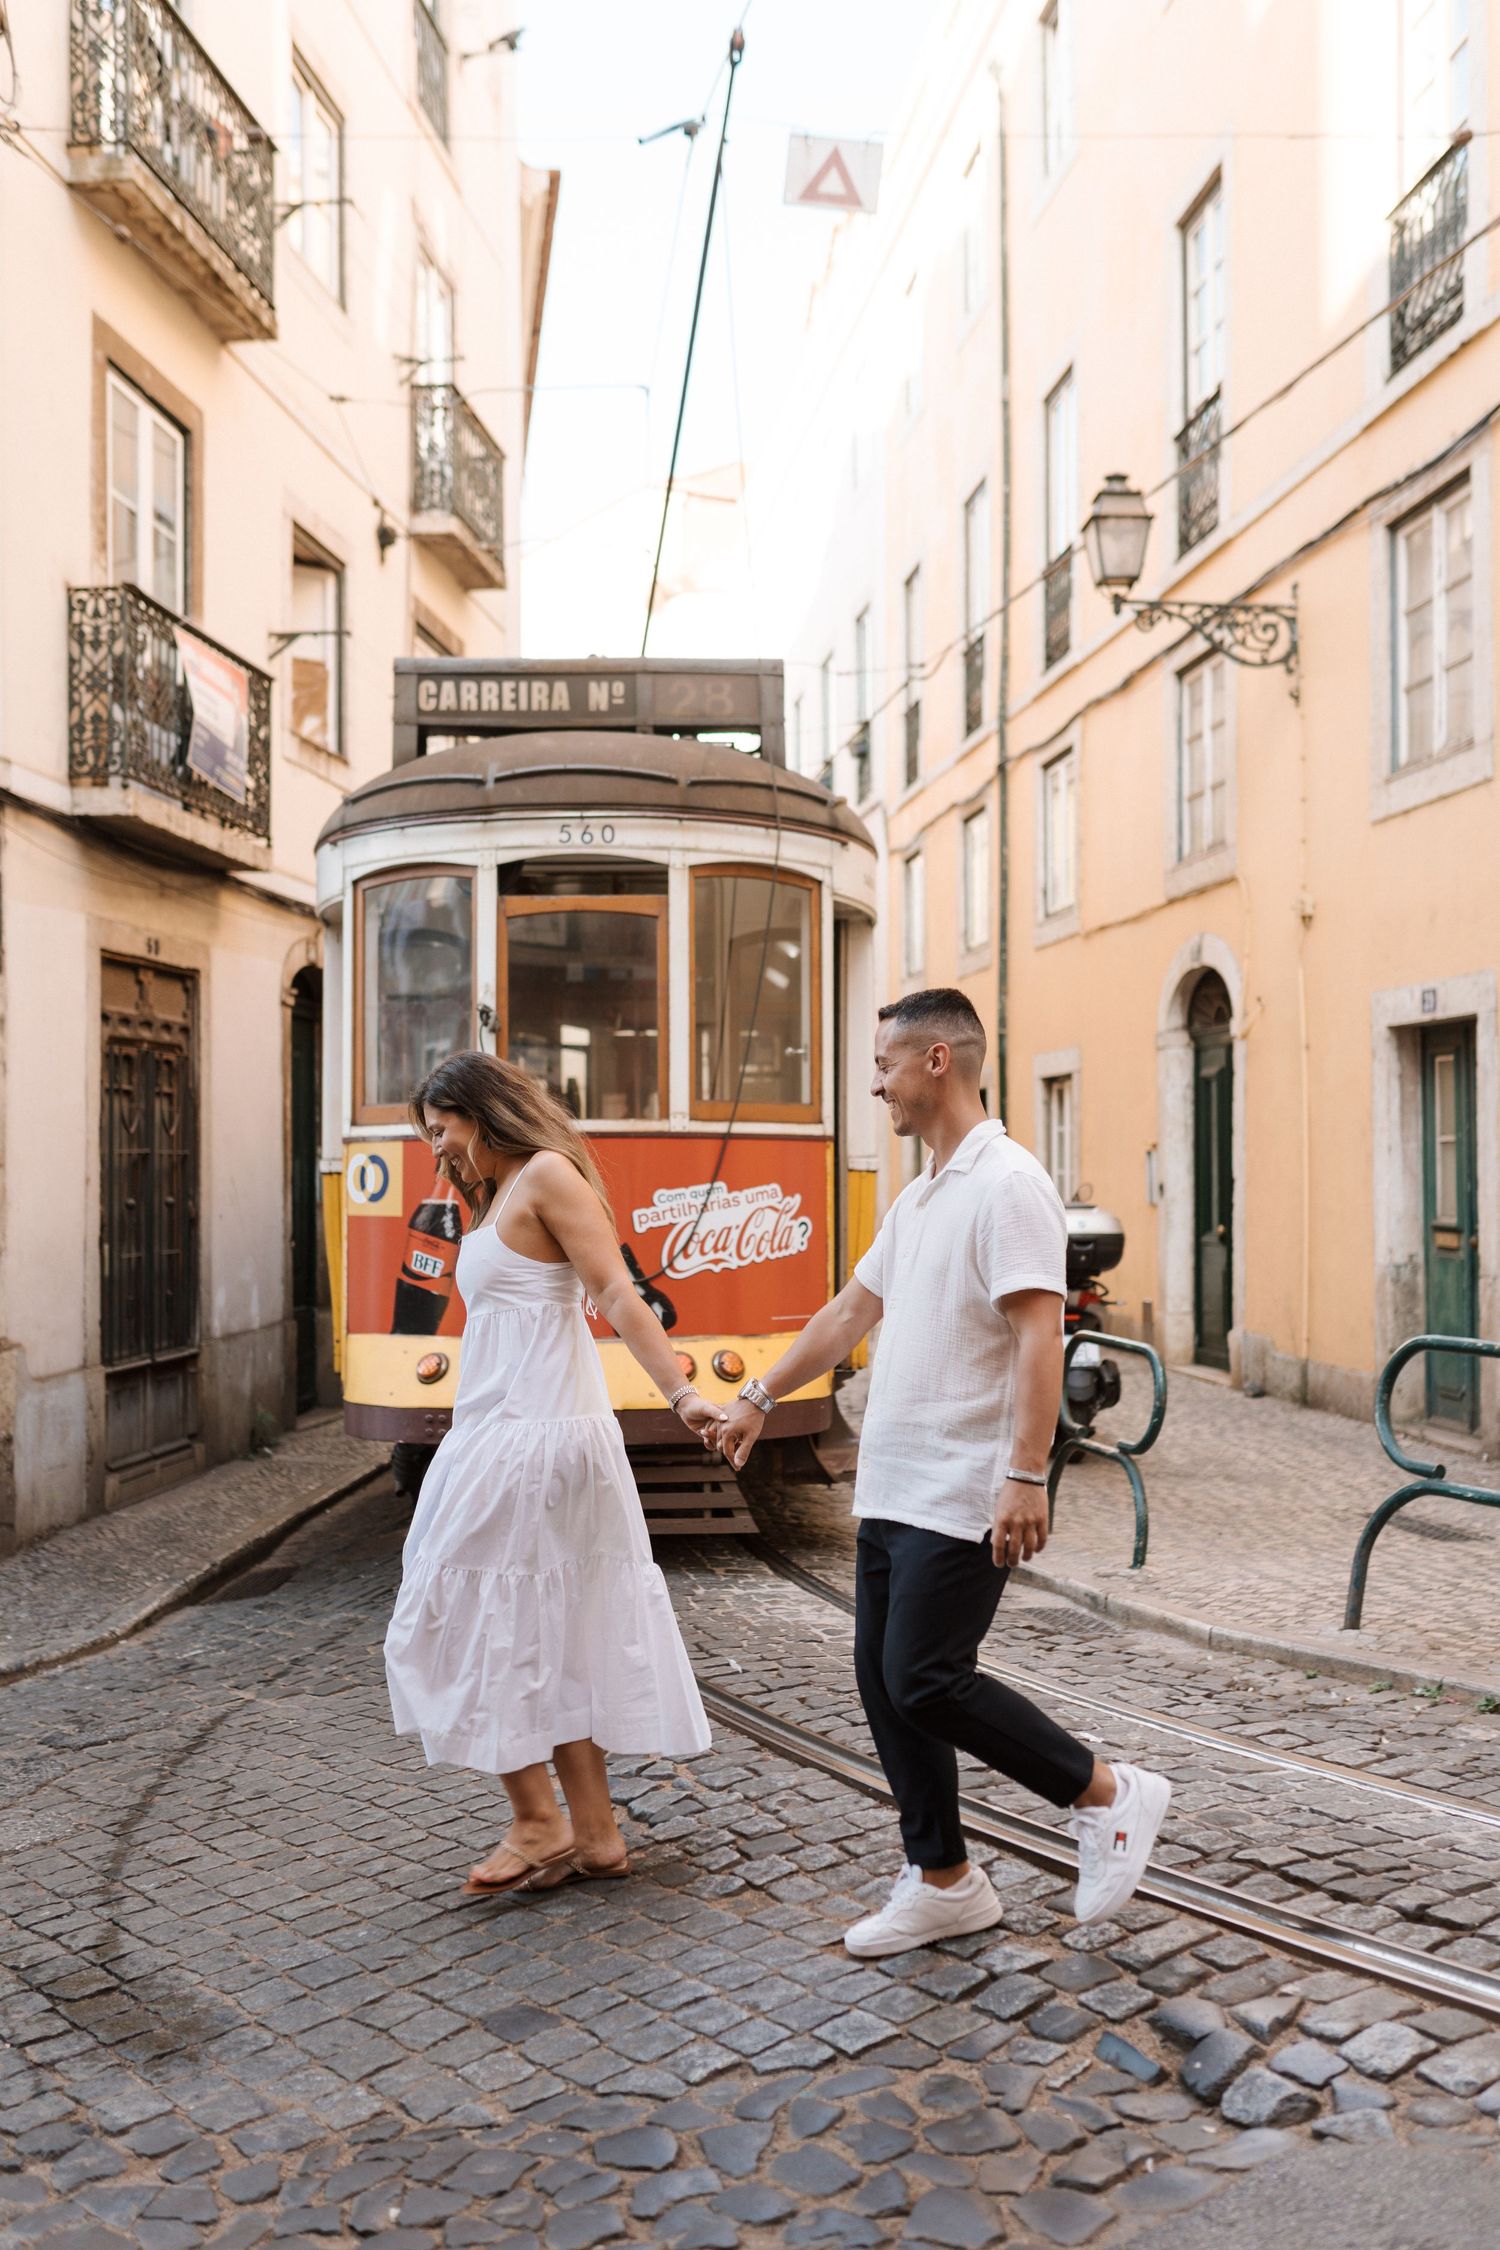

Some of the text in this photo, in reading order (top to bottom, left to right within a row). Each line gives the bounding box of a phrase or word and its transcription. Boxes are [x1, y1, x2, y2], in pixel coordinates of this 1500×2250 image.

[417, 679, 626, 712] CARREIRA Nº
[671, 681, 734, 717] 28
[558, 823, 616, 845] 560
[637, 1187, 779, 1227] partilharias uma
[657, 1190, 687, 1204] Com
[413, 1253, 442, 1274] BFF
